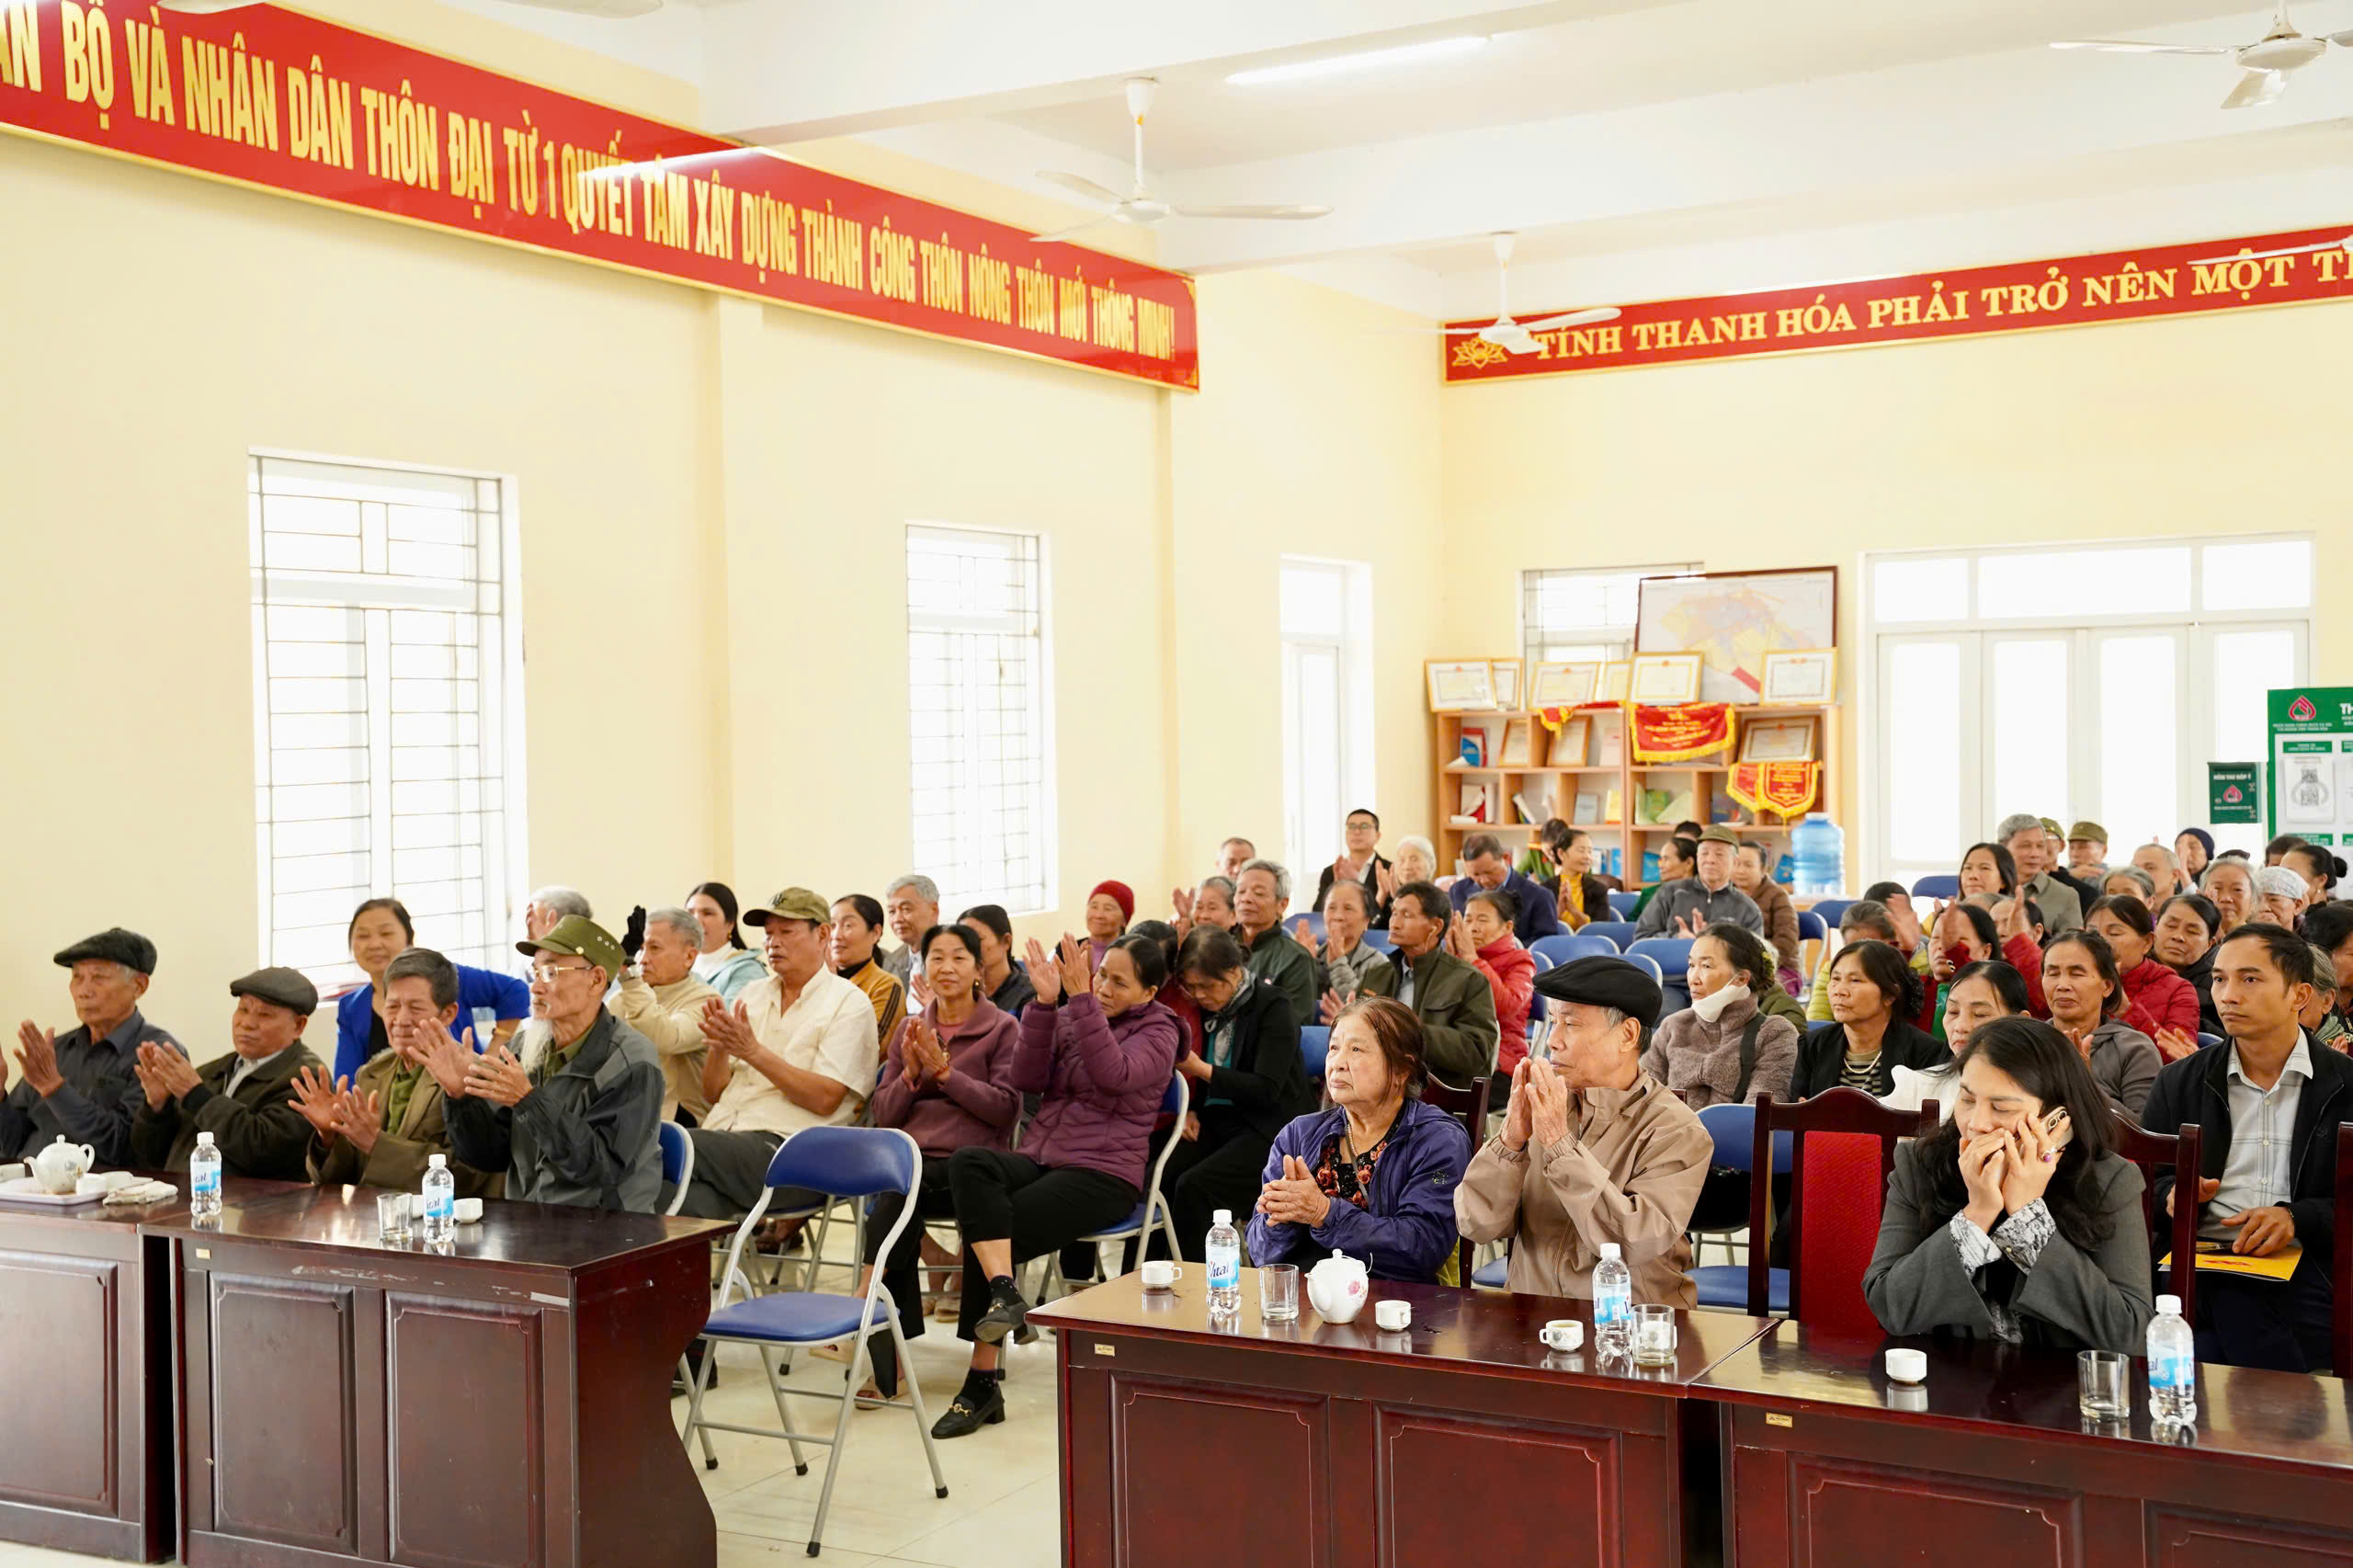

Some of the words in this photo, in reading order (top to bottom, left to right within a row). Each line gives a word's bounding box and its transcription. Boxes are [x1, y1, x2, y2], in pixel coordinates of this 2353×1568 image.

[61, 0, 114, 131] BỘ
[125, 6, 176, 125] VÀ
[182, 31, 278, 152] NHÂN
[287, 53, 354, 170] DÂN
[360, 79, 439, 191] THÔN
[448, 111, 494, 219] ĐẠI
[503, 109, 539, 216] TỪ
[543, 141, 556, 219] 1
[562, 130, 633, 237] QUYẾT
[640, 153, 689, 250] TÂM
[694, 168, 734, 260] XÂY
[741, 190, 797, 284] DỰNG
[801, 199, 863, 290] THÀNH
[870, 215, 915, 303] CÔNG
[920, 231, 963, 313] THÔN
[969, 243, 1011, 324] NÔNG
[1016, 258, 1055, 335] THÔN
[1060, 265, 1087, 343] MỚI
[1092, 278, 1134, 353] THÔNG
[1632, 312, 1768, 350] THANH
[1776, 294, 1857, 337] HÓA
[1868, 280, 1970, 329] PHẢI
[1981, 267, 2069, 316] TRỞ
[2082, 262, 2178, 307] NÊN
[2191, 248, 2296, 301] MỘT
